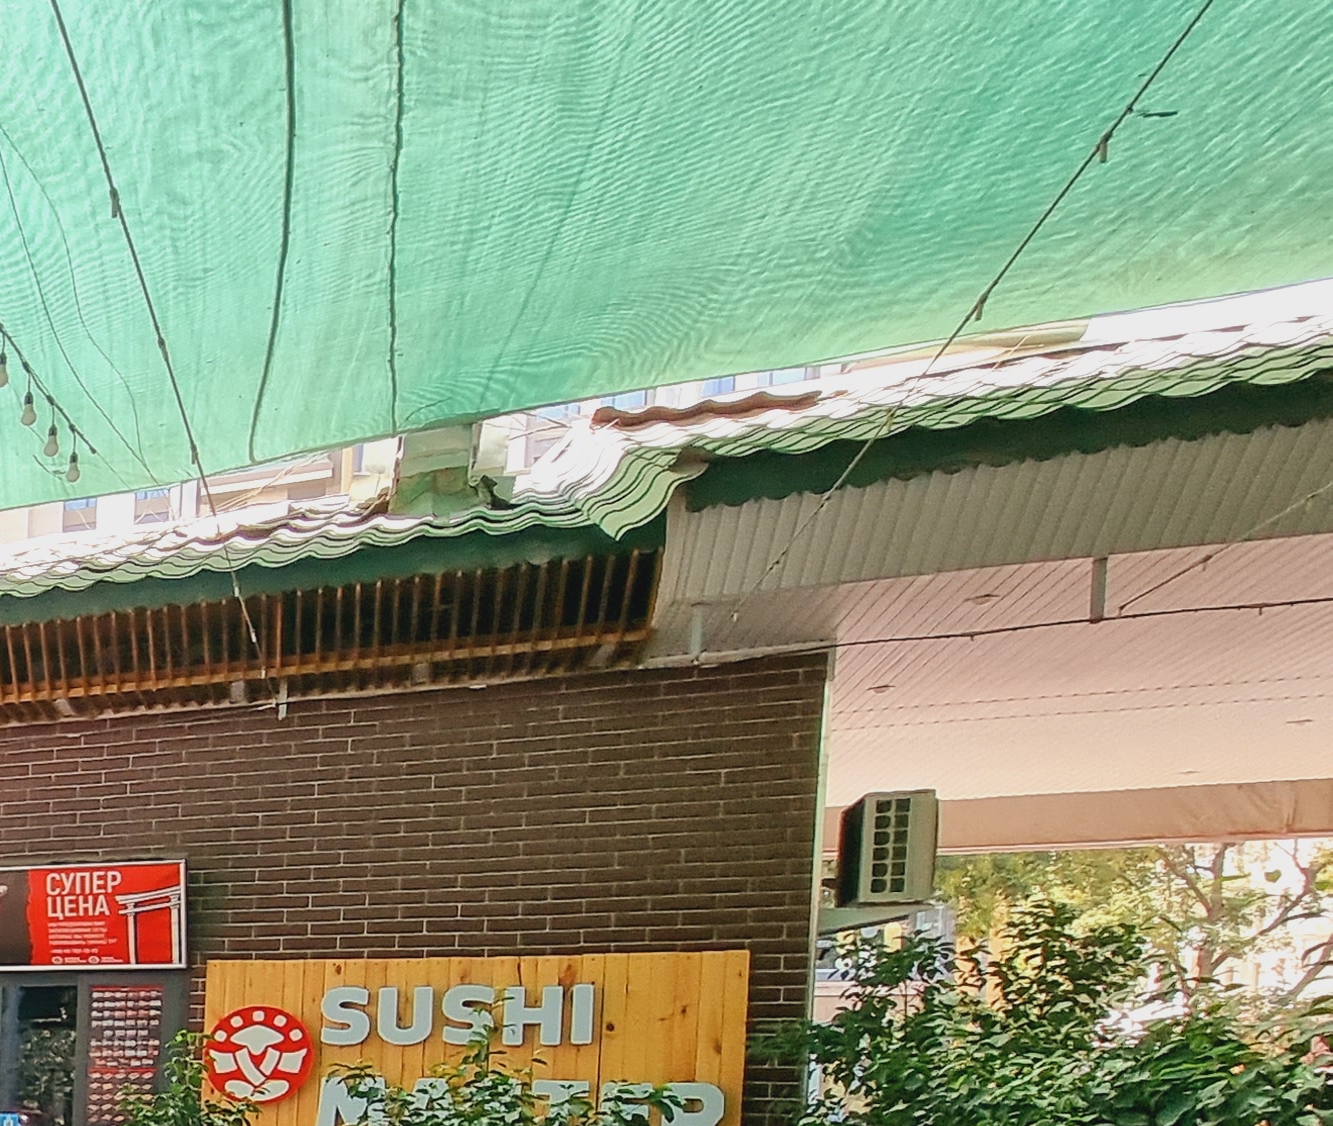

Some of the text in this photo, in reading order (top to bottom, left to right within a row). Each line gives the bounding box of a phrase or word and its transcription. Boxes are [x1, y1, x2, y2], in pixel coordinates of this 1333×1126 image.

[46, 870, 122, 895] СУПЕР
[46, 895, 111, 920] ЦЕНА
[320, 984, 595, 1047] SUSHI
